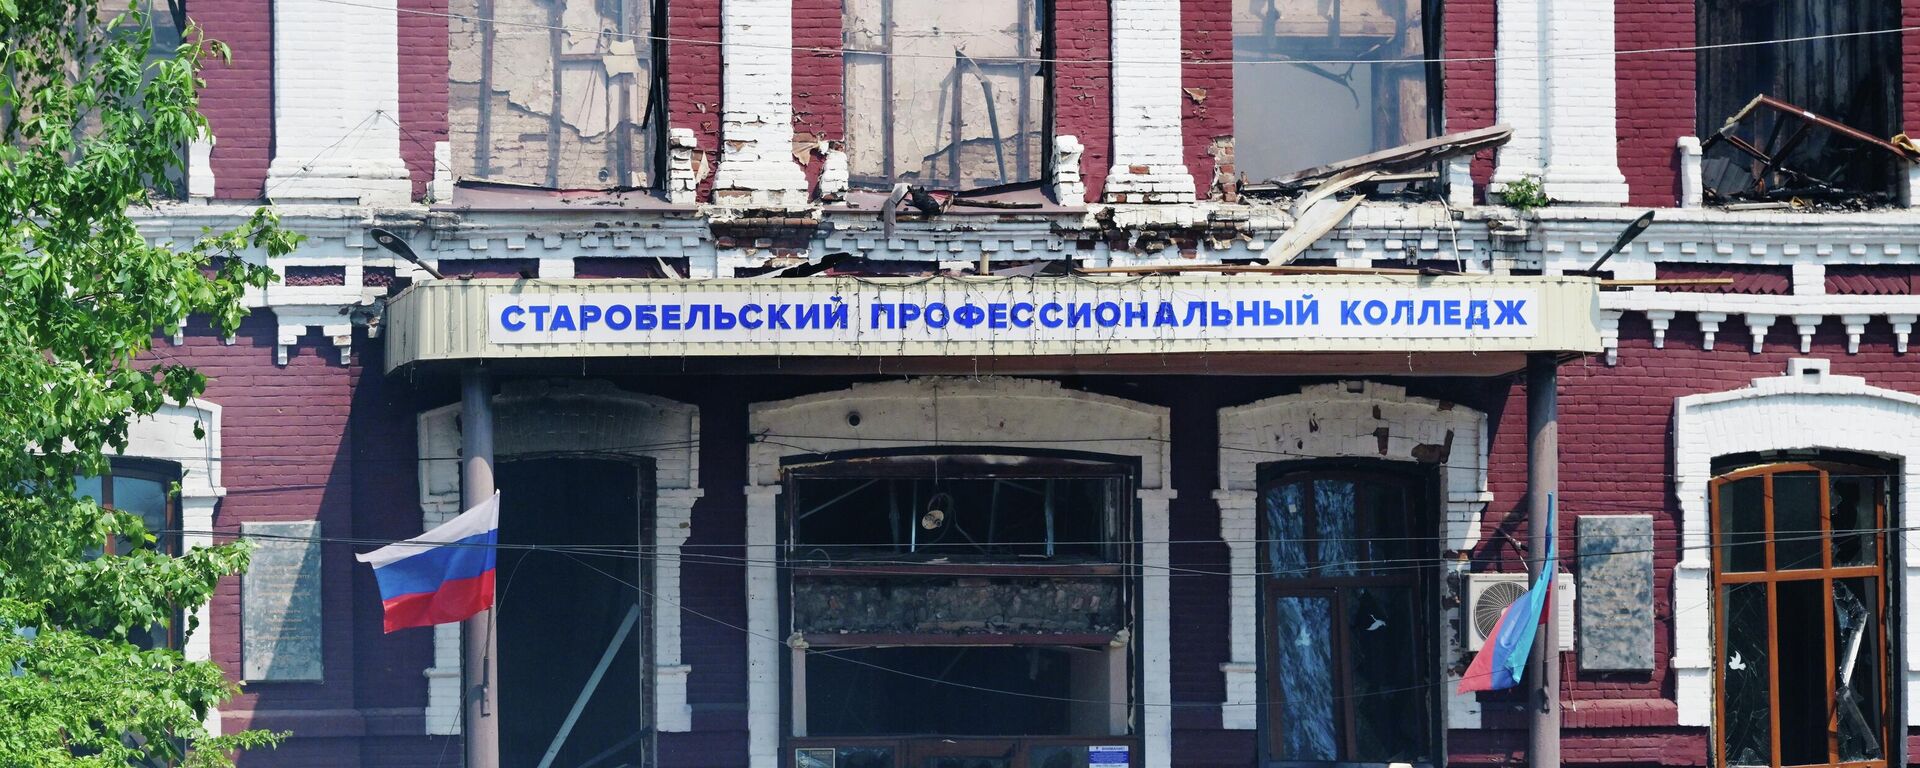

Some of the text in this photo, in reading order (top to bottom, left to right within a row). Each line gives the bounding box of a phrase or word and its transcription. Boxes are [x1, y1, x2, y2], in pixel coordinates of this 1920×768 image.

[500, 294, 1527, 332] СТАРОБЕЛЬСКИЙ ПРОФЕССИОНАЛЬНЫЙ КОЛЛЕДЖ
